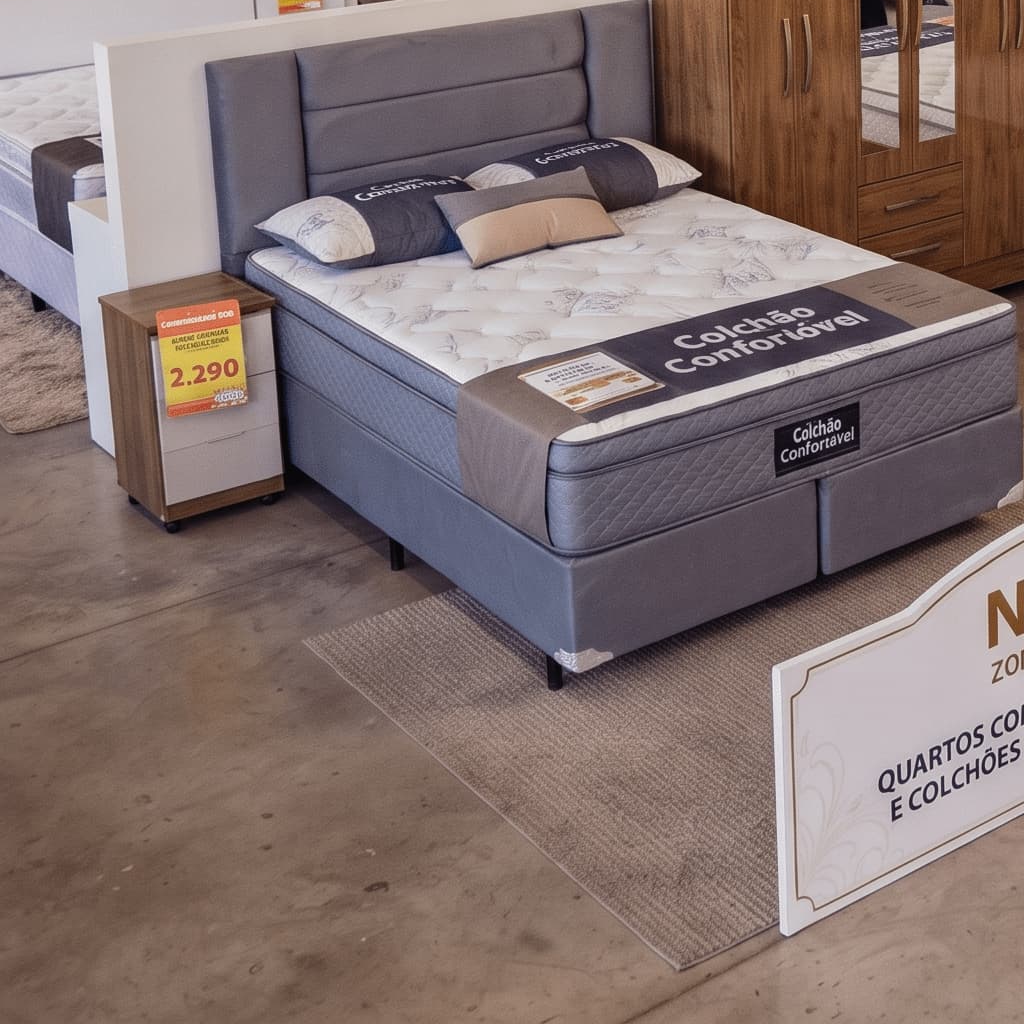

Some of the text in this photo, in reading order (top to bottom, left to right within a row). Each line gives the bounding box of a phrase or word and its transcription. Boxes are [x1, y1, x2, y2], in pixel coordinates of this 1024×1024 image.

[673, 307, 816, 350] Colchão
[170, 358, 239, 388] 2.290
[793, 417, 842, 443] Colchão
[878, 724, 985, 794] QUARTOS
[891, 796, 903, 823] E
[908, 739, 1021, 811] COLCHÕES
